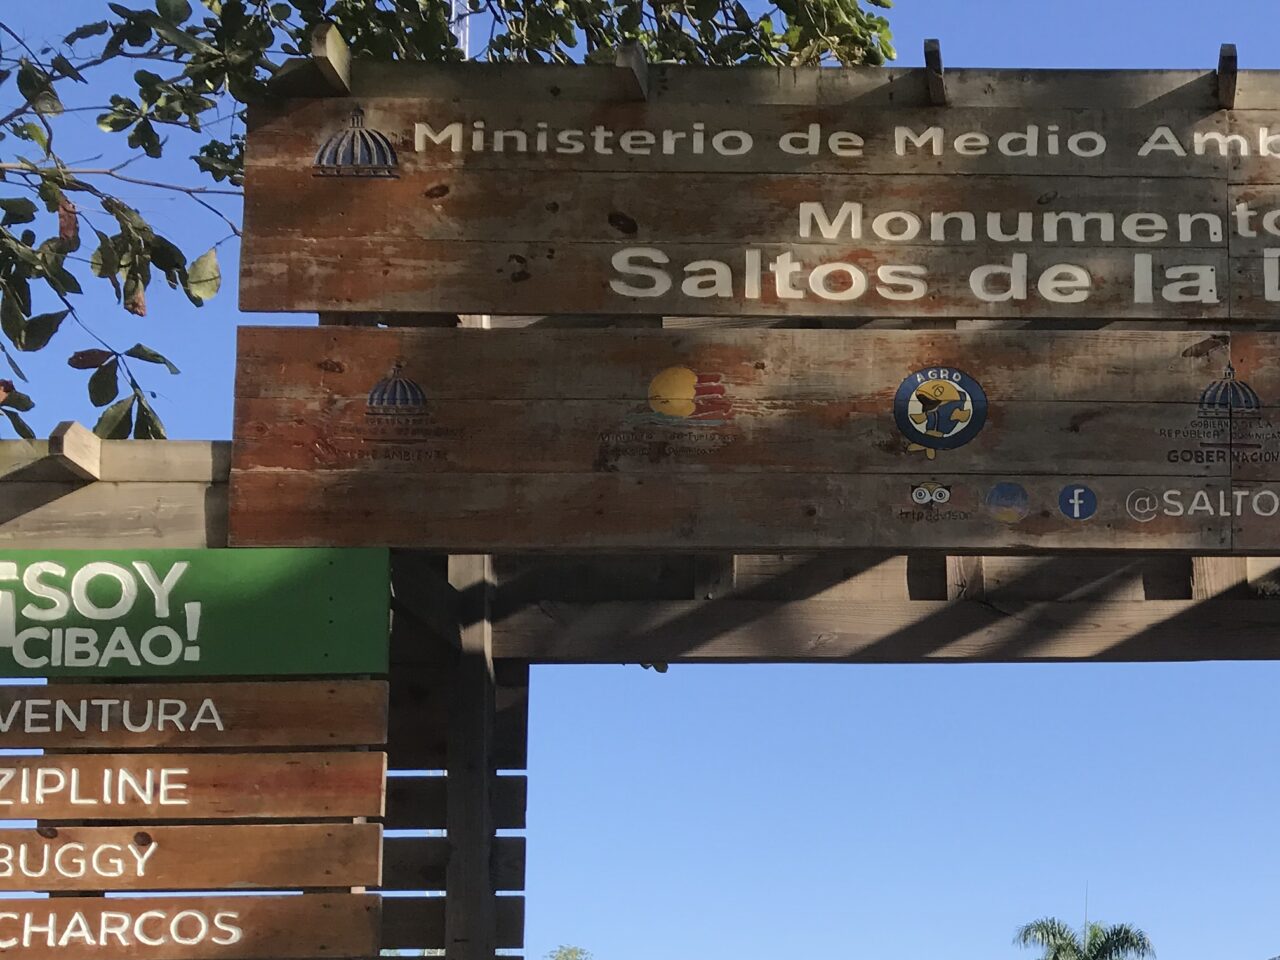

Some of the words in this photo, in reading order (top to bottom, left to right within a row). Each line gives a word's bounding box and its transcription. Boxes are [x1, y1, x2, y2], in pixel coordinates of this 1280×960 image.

[414, 120, 755, 156] Ministerio
[780, 123, 865, 157] de
[895, 126, 1108, 158] Medio
[609, 246, 929, 301] Saltos
[970, 252, 1091, 304] de
[1133, 253, 1220, 305] la
[12, 602, 201, 668] CIBAO!
[0, 767, 190, 805] ZIPLINE
[0, 841, 159, 879] BUGGY
[0, 910, 243, 948] CHARCOS
